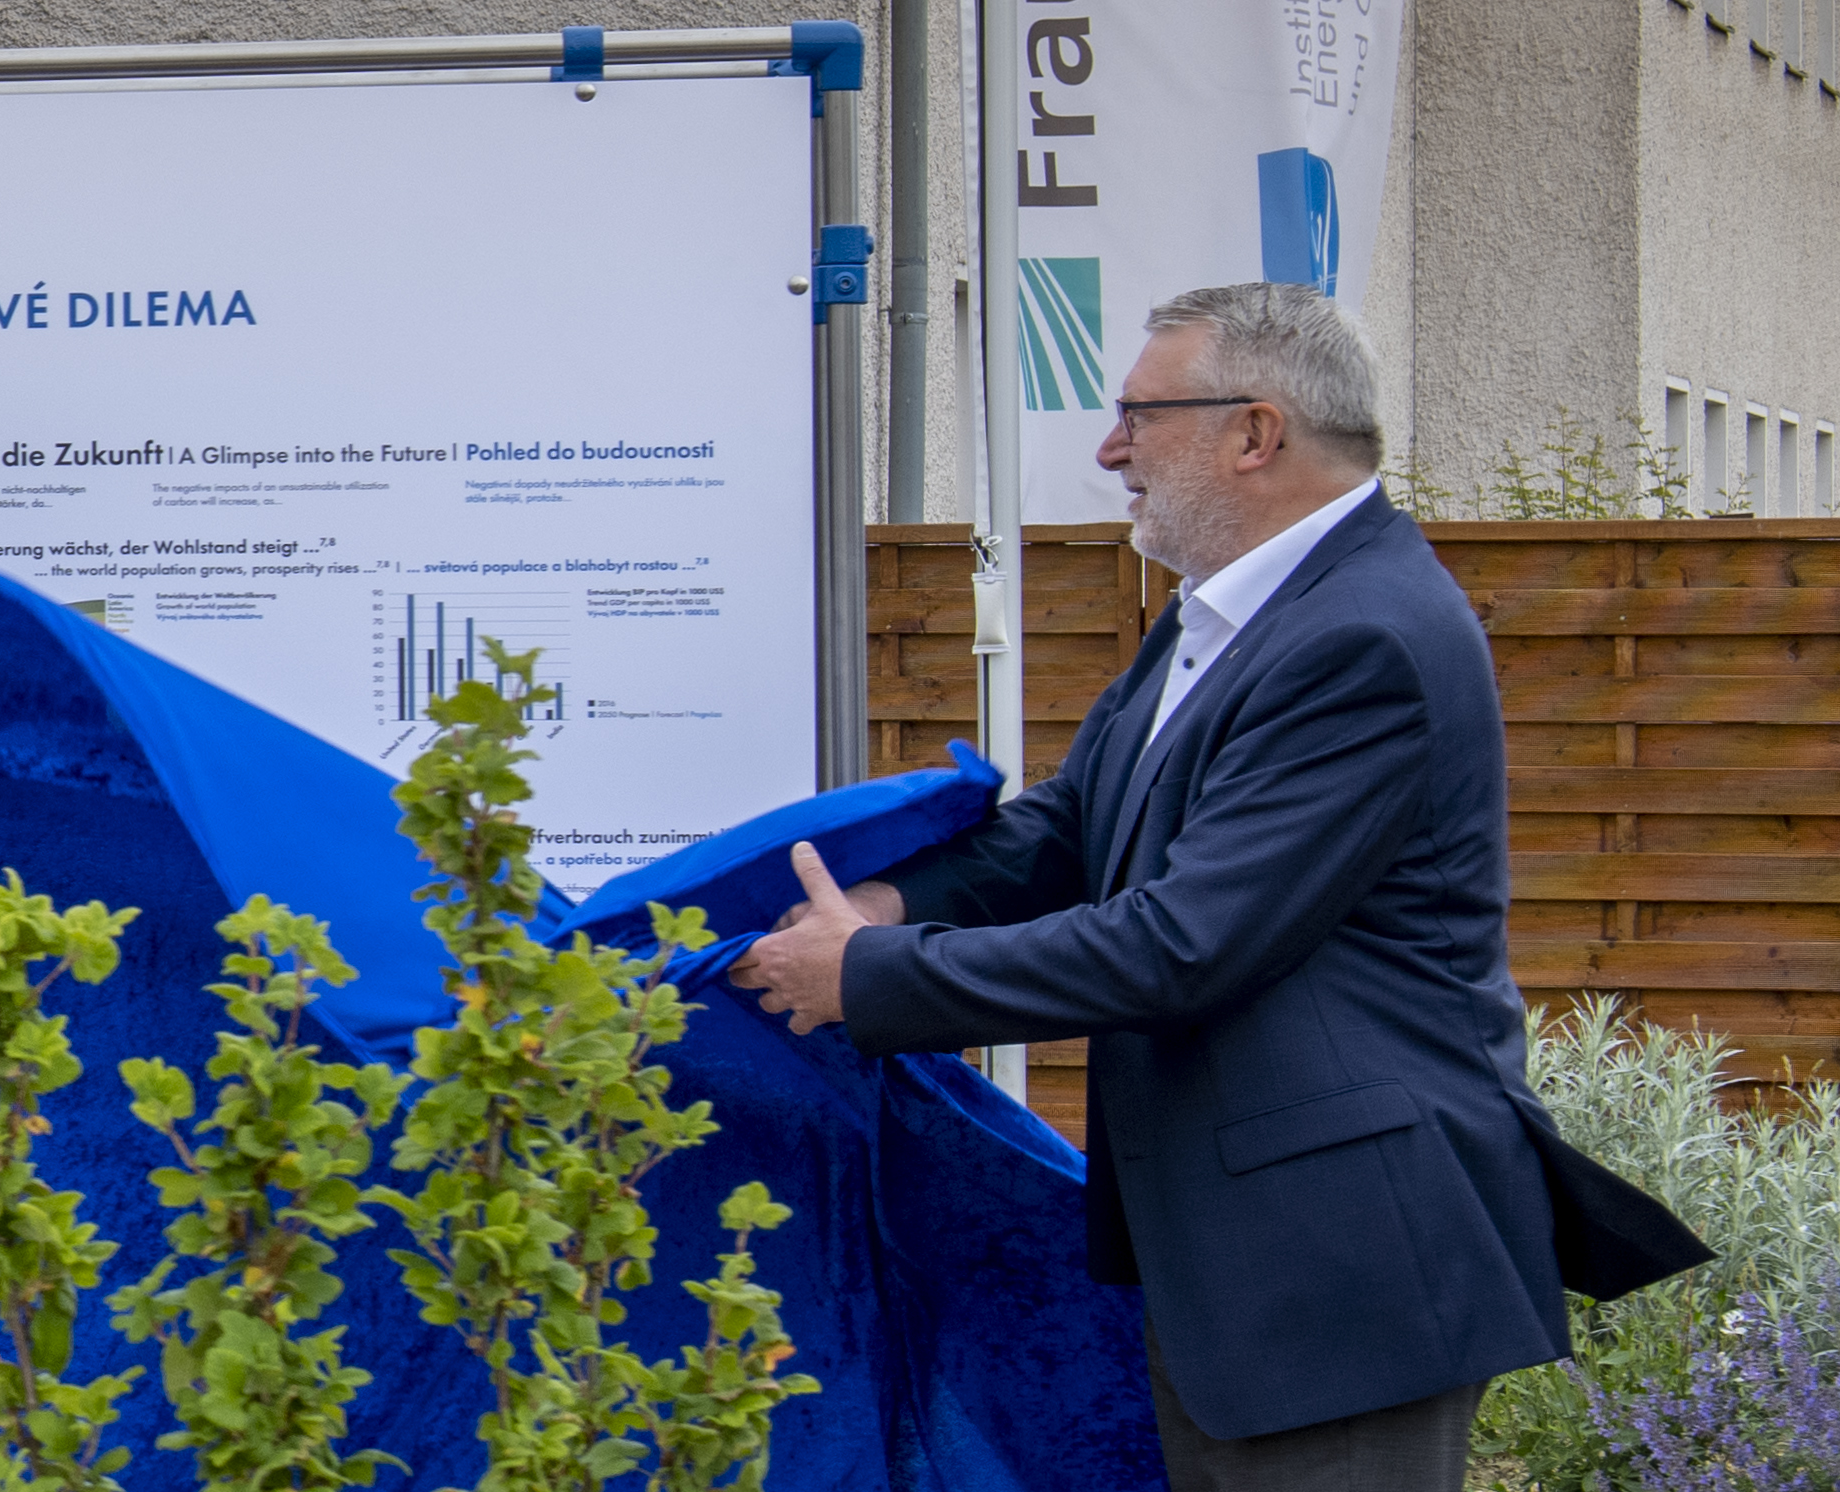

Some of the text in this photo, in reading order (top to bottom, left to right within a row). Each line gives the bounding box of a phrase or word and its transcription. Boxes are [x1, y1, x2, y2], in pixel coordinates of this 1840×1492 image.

[1313, 0, 1339, 108] Ener
[1348, 33, 1369, 116] und
[1018, 0, 1099, 207] Fra
[68, 289, 257, 329] DILEMA
[1, 441, 46, 468] die
[53, 439, 164, 467] Zukunft
[178, 447, 196, 465] A
[201, 445, 289, 468] Glimpse
[295, 445, 335, 464] into
[340, 443, 374, 463] the
[381, 444, 447, 462] Future
[466, 441, 540, 462] Pohled
[546, 441, 576, 461] do
[581, 440, 714, 460] budoucnosti
[48, 538, 299, 558] wächst, der Wohlstand steigt
[50, 561, 360, 579] the world population grows, prosperity rises
